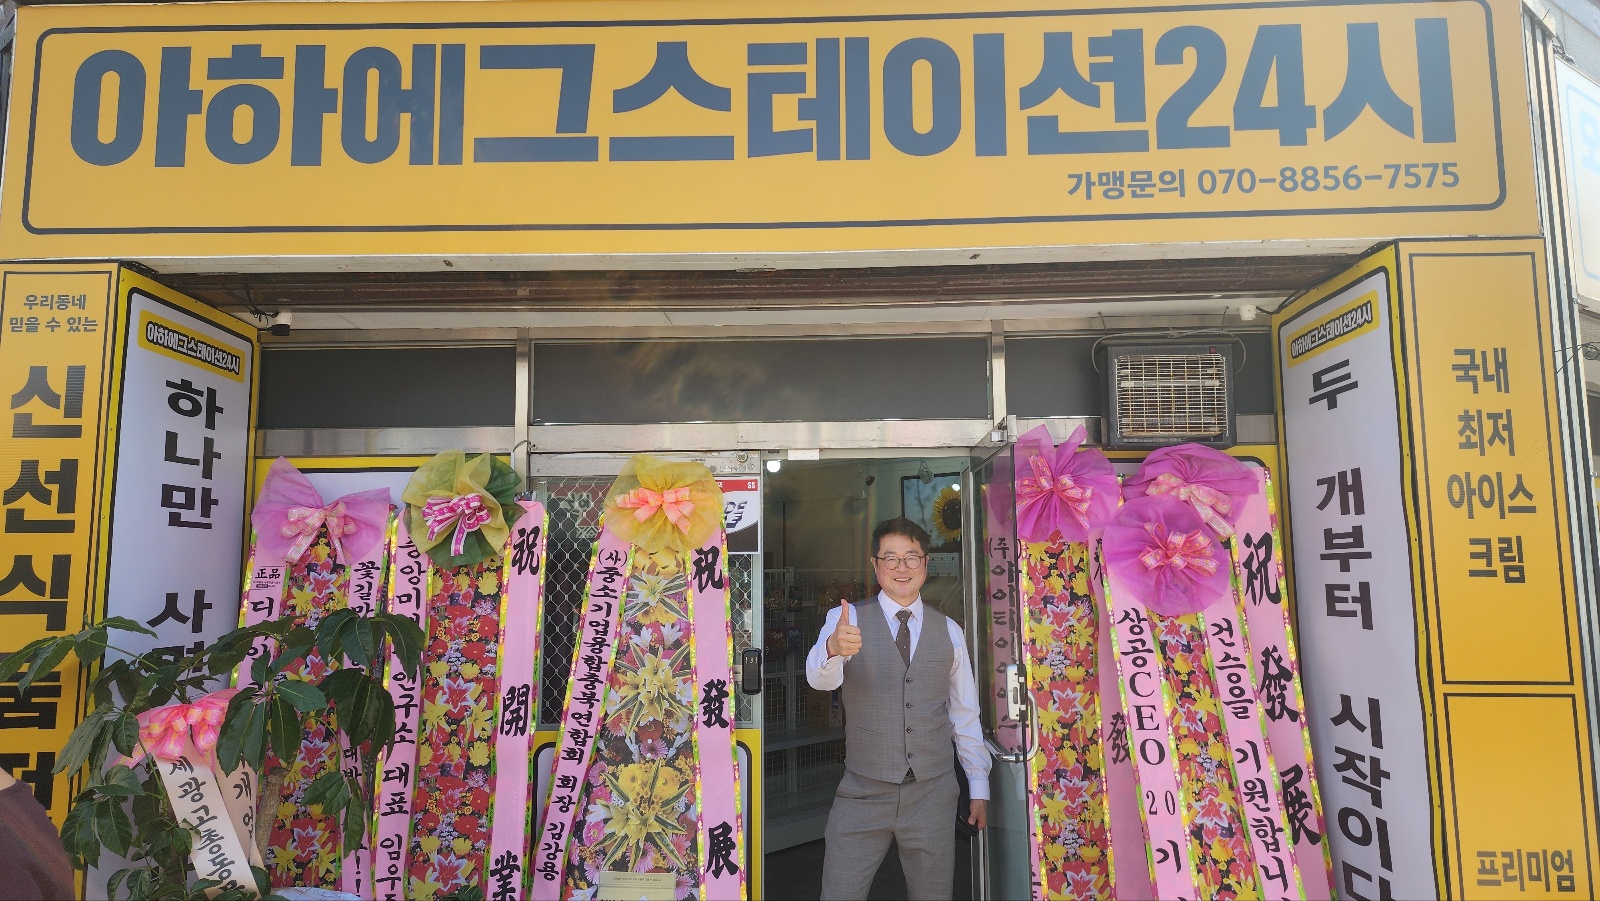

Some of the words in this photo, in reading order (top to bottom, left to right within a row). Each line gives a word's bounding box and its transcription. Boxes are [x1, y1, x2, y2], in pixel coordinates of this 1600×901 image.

[70, 17, 1457, 168] 아하에그스테이션24시
[1067, 169, 1186, 200] 가맹문의
[1197, 162, 1460, 195] 070-8856-7575
[9, 317, 41, 333] 믿을
[45, 317, 61, 332] 수
[66, 317, 98, 333] 있는
[23, 294, 87, 310] 우리동네
[146, 321, 240, 375] 아하에그스테이션24시
[1291, 300, 1373, 359] 아하에그스테이션24시
[1309, 358, 1359, 411] 두
[1451, 347, 1510, 394] 국내
[160, 378, 224, 530] 하나만
[1457, 409, 1516, 457] 최저
[1446, 472, 1537, 520] 아이스
[255, 567, 281, 580] 正品
[1316, 467, 1374, 631] 개부터
[1468, 535, 1526, 584] 크림
[1117, 607, 1166, 766] 상공CEO
[1211, 617, 1253, 719] 건승을
[1235, 740, 1289, 901] 기원합니
[381, 762, 410, 817] 대표
[551, 775, 578, 814] 회장
[375, 833, 403, 901] 임우
[536, 821, 566, 881] 김강용
[1476, 849, 1576, 892] 프리미엄
